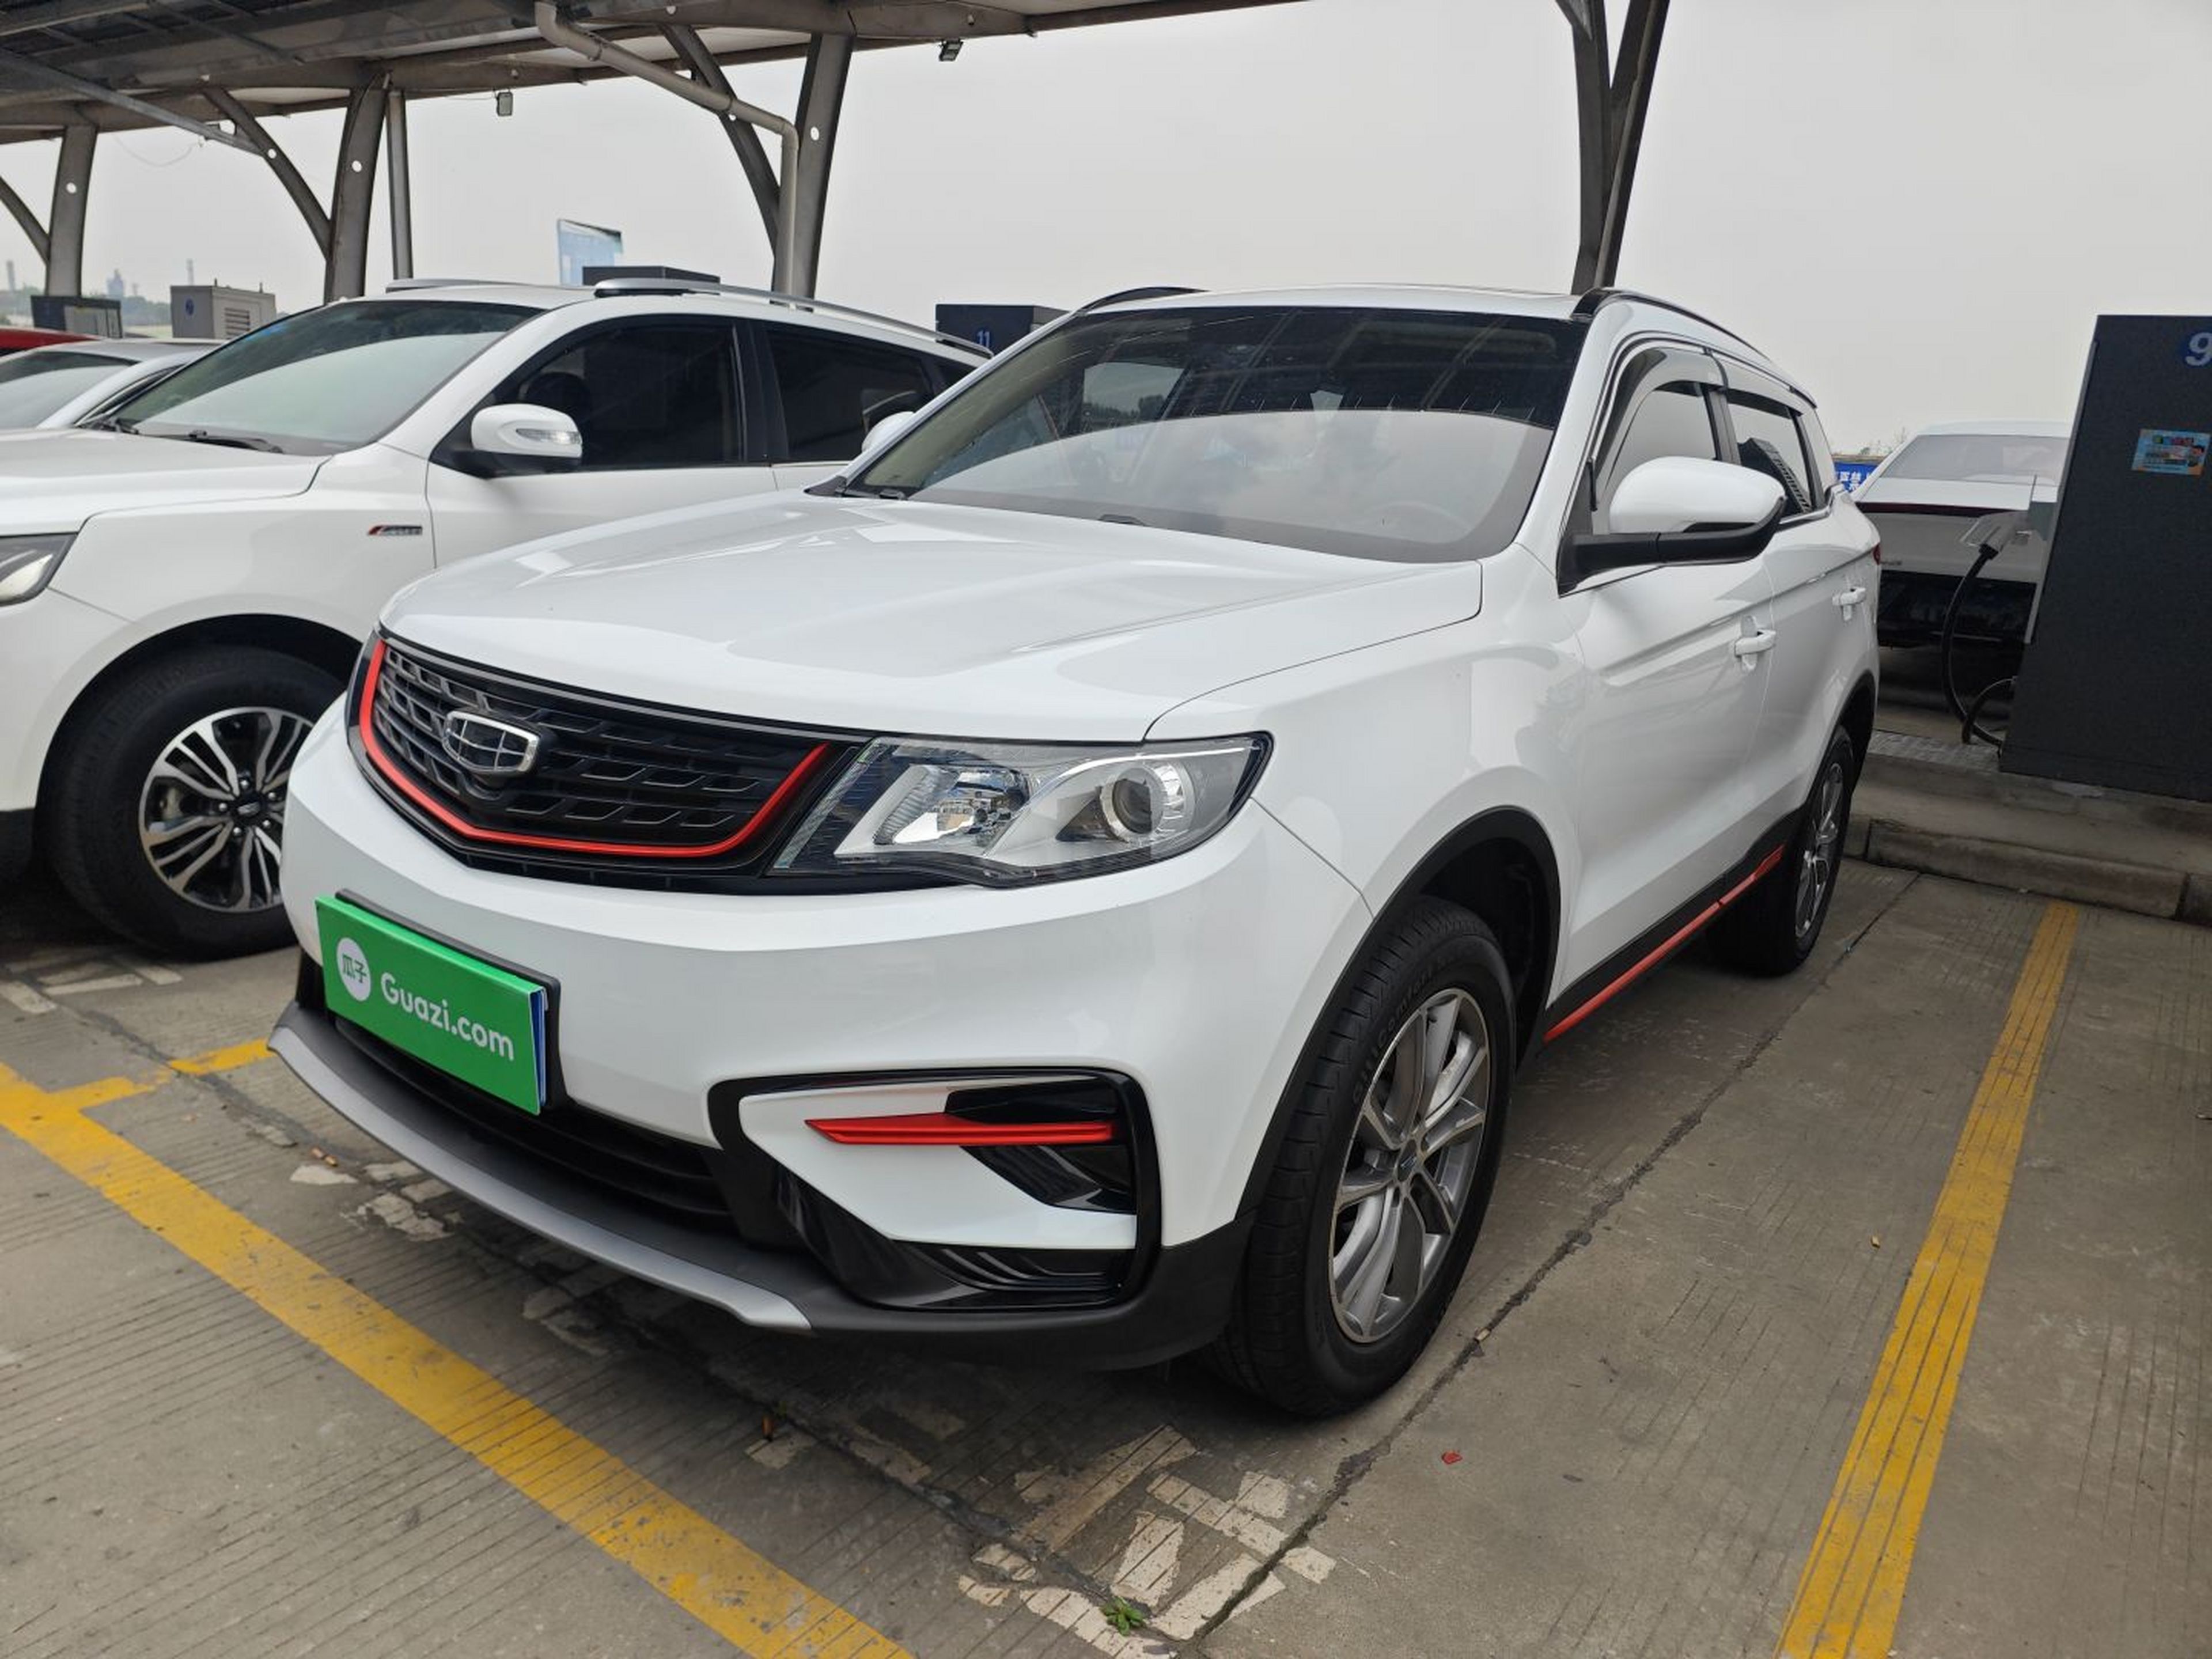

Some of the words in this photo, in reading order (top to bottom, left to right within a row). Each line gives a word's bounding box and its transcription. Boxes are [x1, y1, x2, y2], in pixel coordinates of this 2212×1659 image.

[978, 330, 990, 348] 11
[2185, 332, 2212, 366] 9
[342, 953, 367, 983] 瓜子
[380, 972, 514, 1061] Guazi.com
